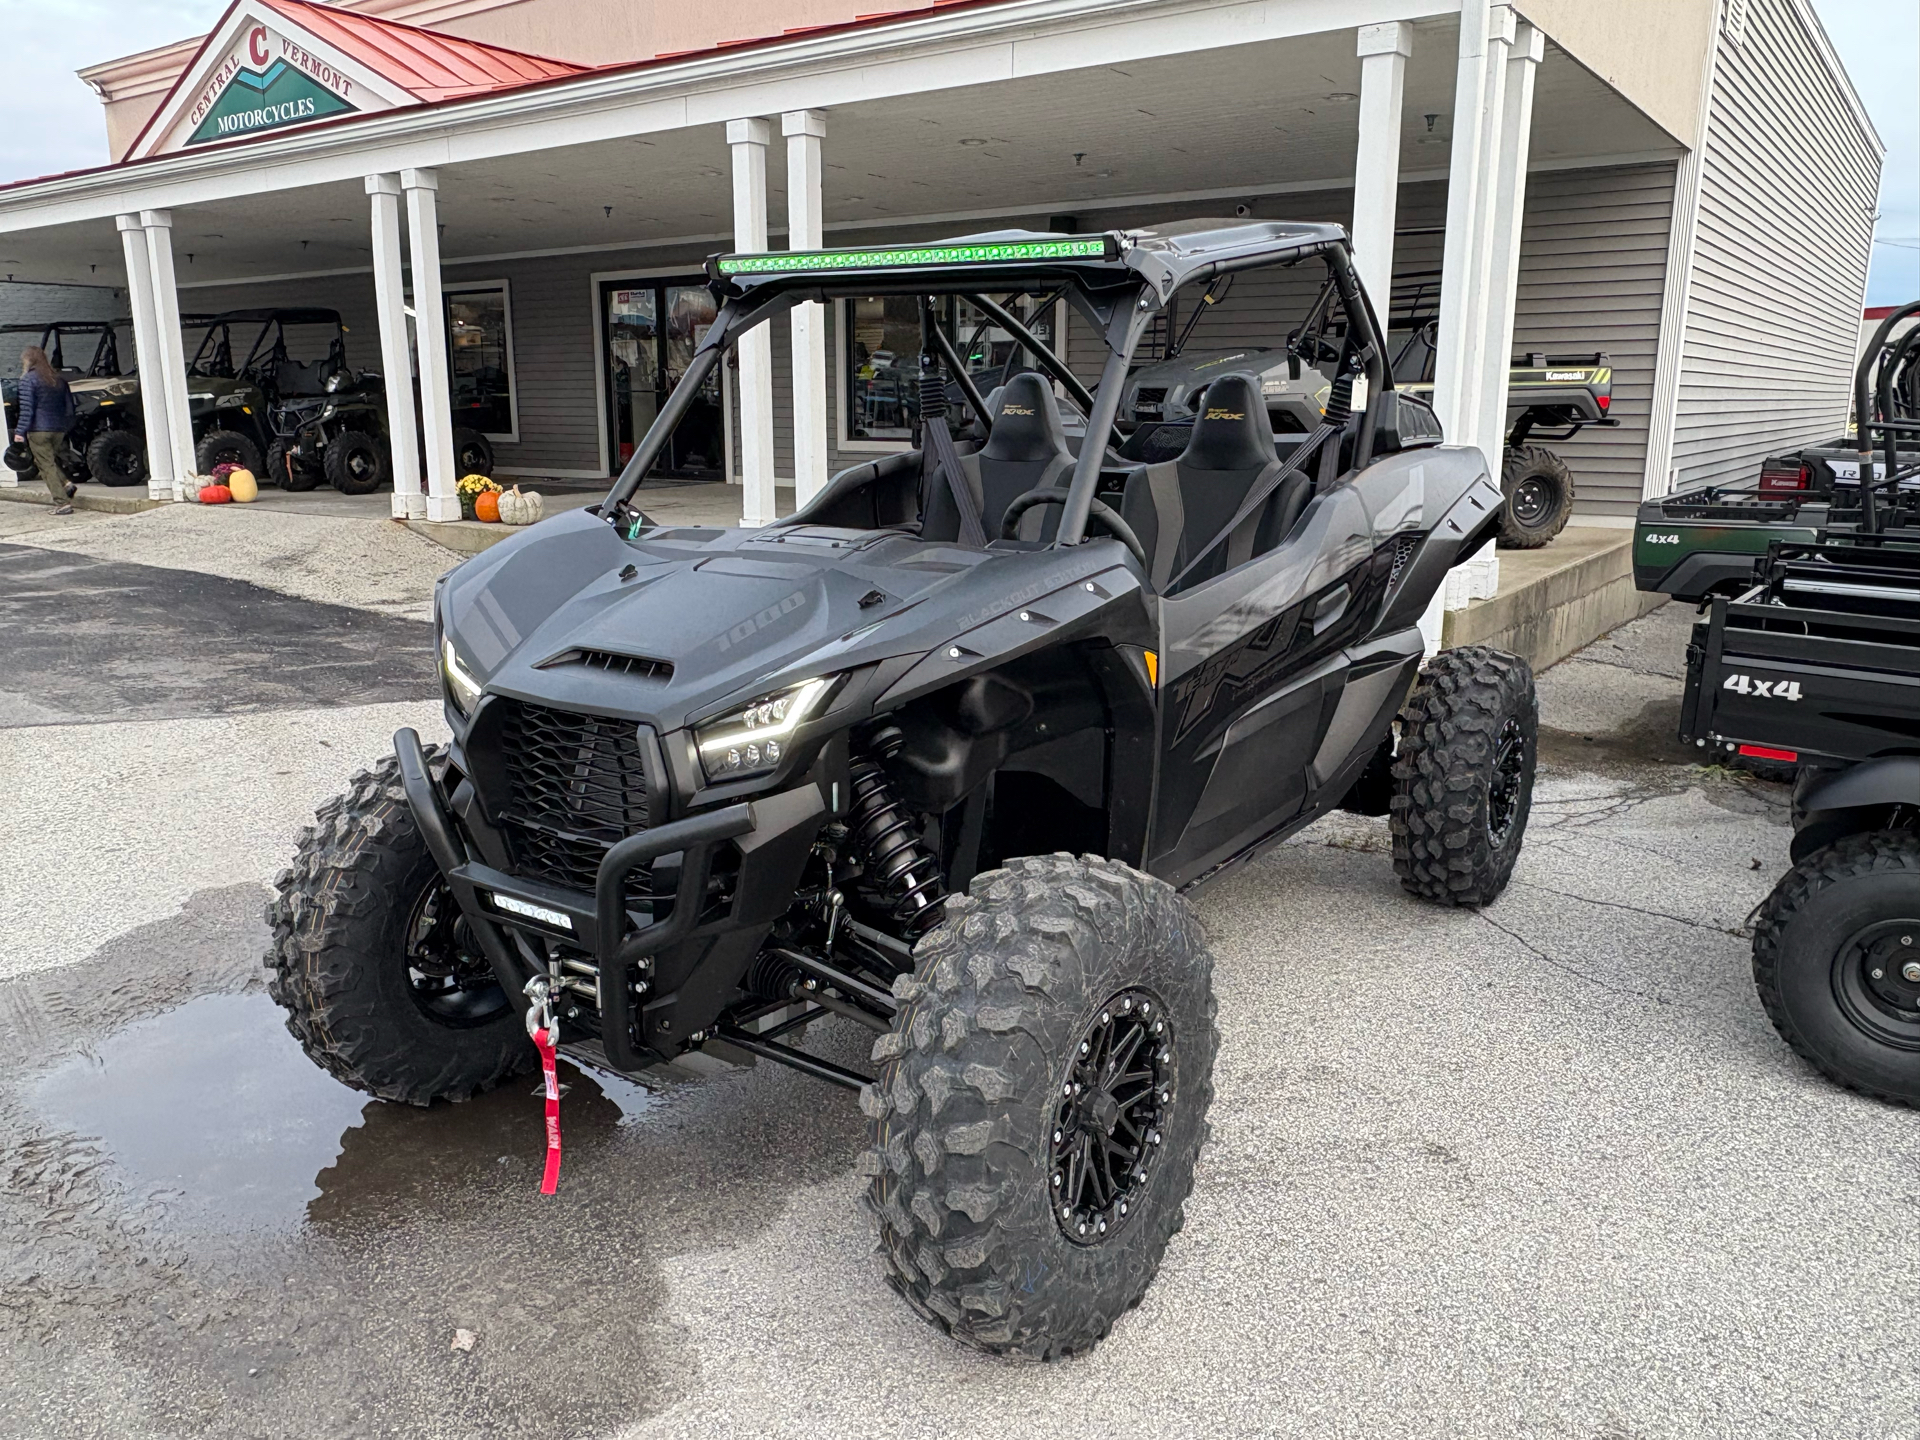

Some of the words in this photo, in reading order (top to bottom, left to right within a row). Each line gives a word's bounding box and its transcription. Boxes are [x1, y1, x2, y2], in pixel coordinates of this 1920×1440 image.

[249, 26, 269, 66] C
[191, 54, 240, 126] CENTRAL
[282, 38, 352, 97] VERMONT
[217, 97, 315, 134] MOTORCYCLES
[1546, 371, 1585, 381] Kawasaki
[1646, 534, 1680, 544] 4x4
[956, 582, 1041, 631] BLACKOUT
[1044, 559, 1097, 589] EDITION
[712, 590, 806, 653] 1000
[1723, 674, 1803, 701] 4x4
[546, 1116, 559, 1150] WARN
